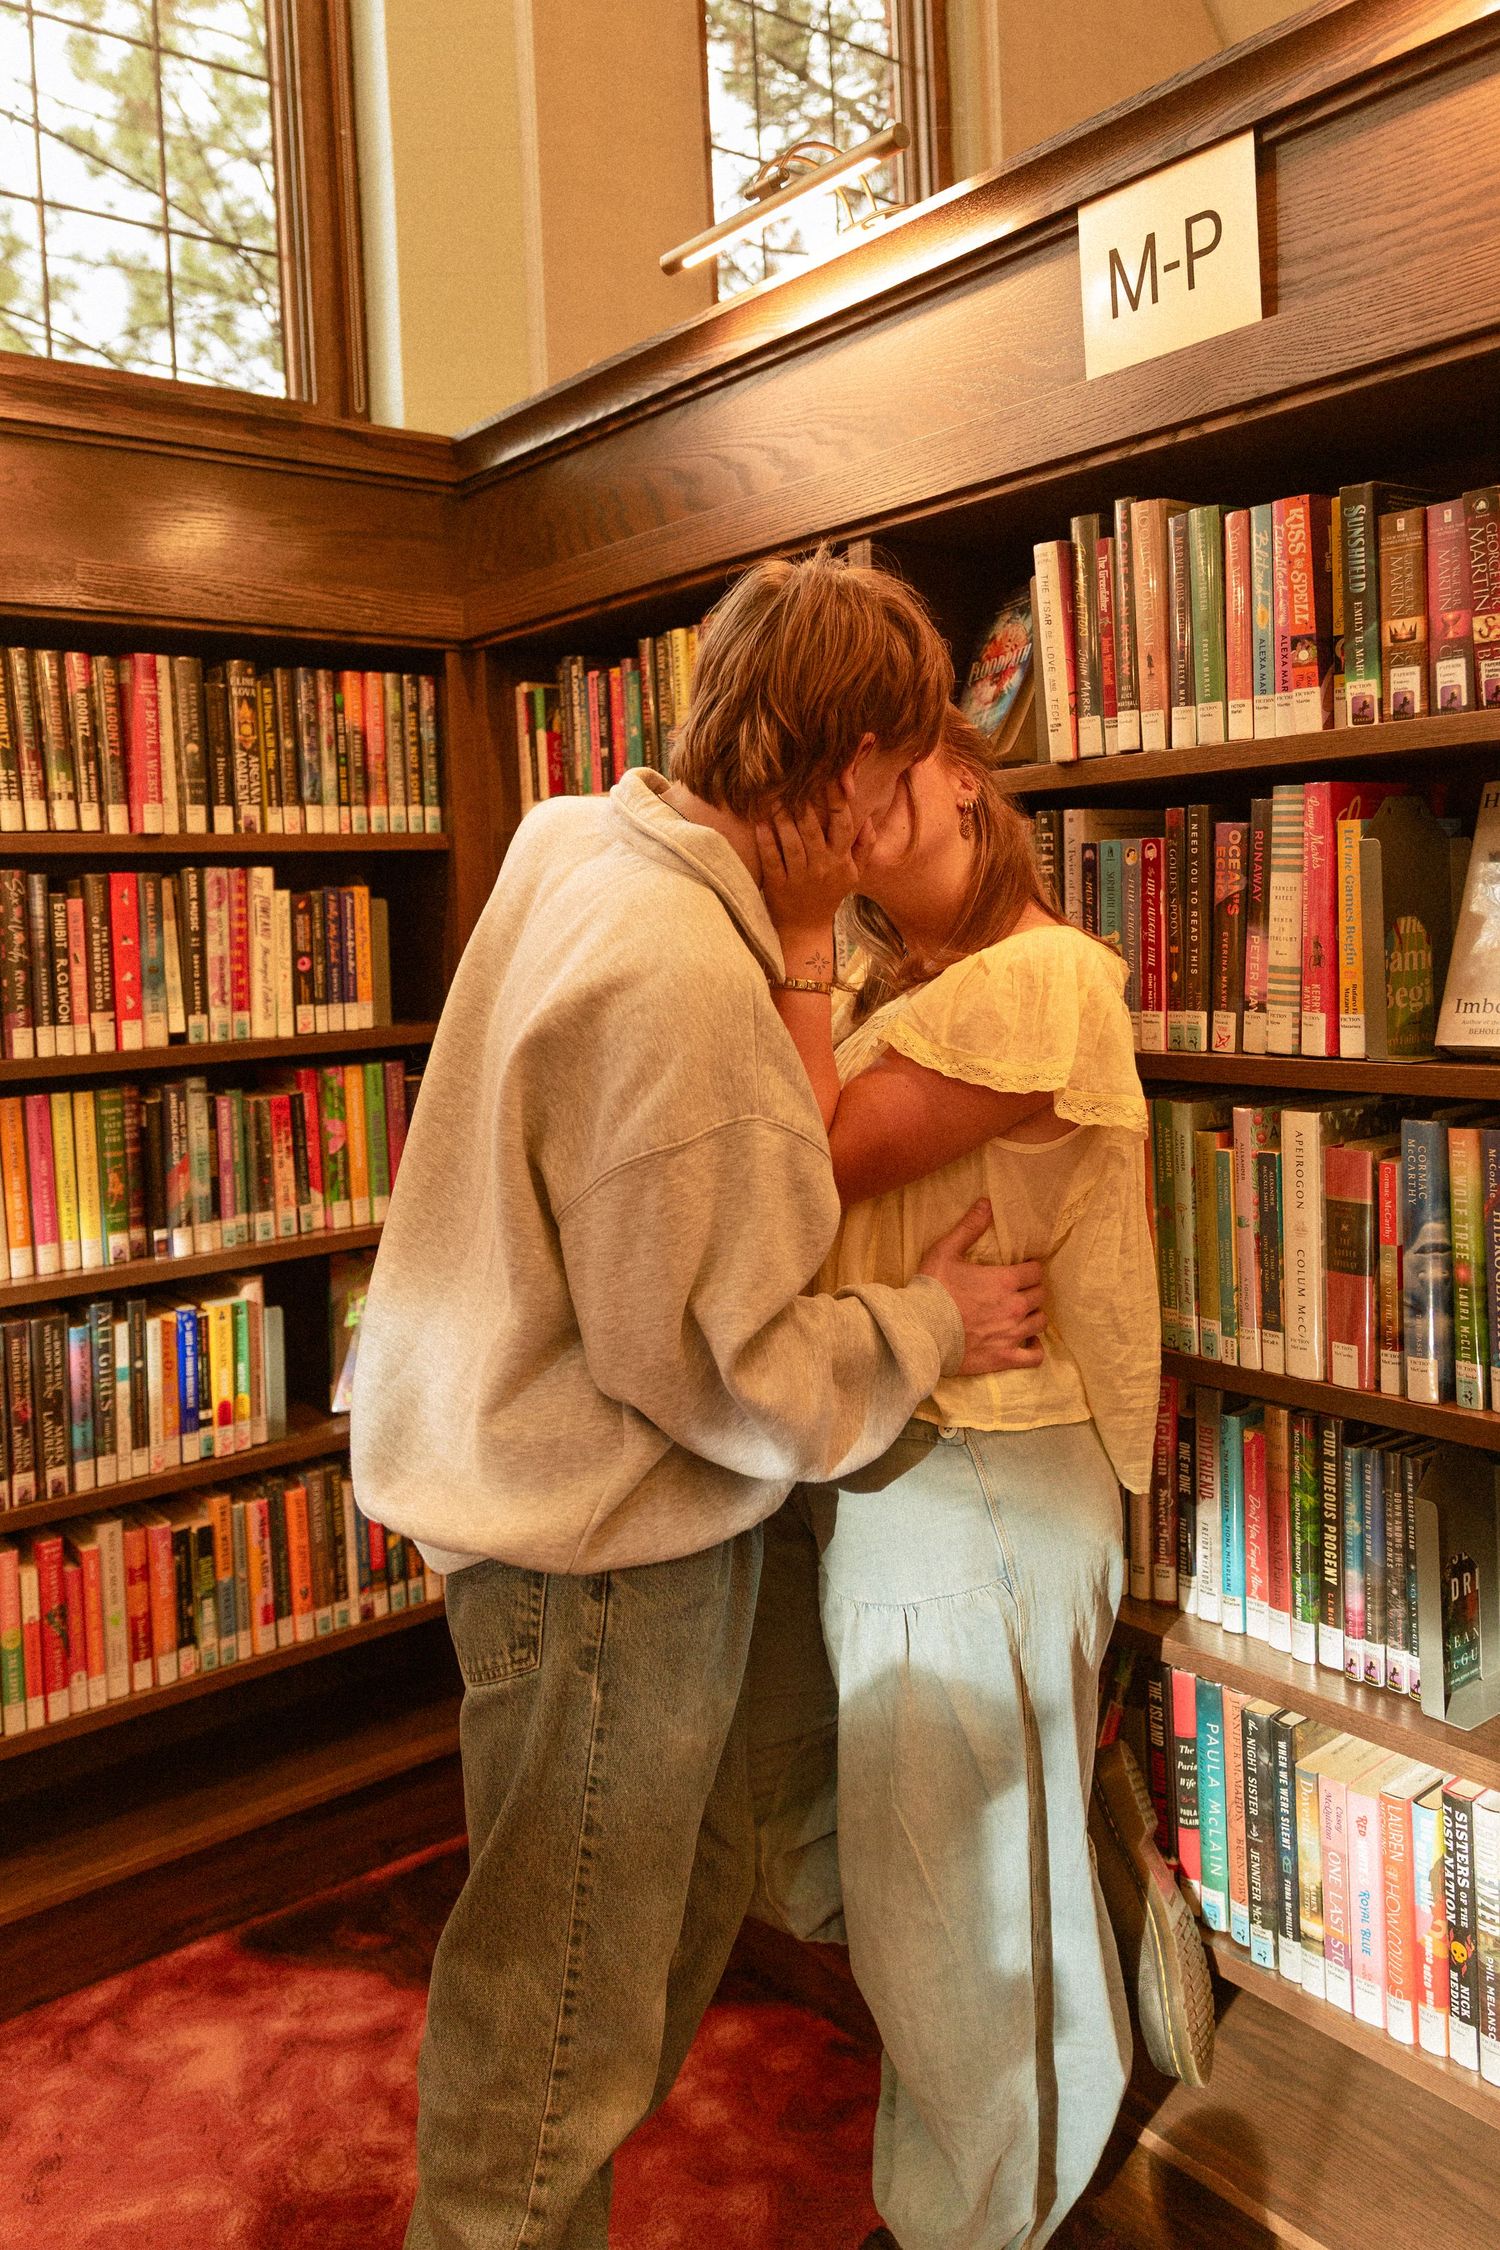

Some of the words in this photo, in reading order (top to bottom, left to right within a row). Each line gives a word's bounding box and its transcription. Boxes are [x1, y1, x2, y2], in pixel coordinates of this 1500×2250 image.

[1108, 209, 1223, 320] M-P
[1285, 507, 1307, 555] KISS
[1344, 504, 1367, 593] SUNSHIELD
[1098, 556, 1108, 570] The
[1175, 536, 1184, 603] MARVELLOUS
[1255, 530, 1270, 595] Blitzed
[1438, 549, 1452, 611] MARTIN
[1468, 526, 1490, 612] MARTIN
[1040, 575, 1050, 593] THE
[1099, 570, 1109, 612] Greenfather
[1290, 571, 1309, 624] SPELL
[1390, 556, 1405, 616] MARTIN
[1043, 600, 1052, 626] TSAR
[1075, 578, 1089, 638] VACATION
[1353, 601, 1364, 633] EMILY
[1046, 646, 1056, 673] LOVE
[1258, 638, 1266, 671] ALEXA
[1280, 634, 1289, 667] ALEXA
[1354, 635, 1363, 646] B.
[75, 660, 85, 689] DEAN
[1077, 649, 1088, 676] JOHN
[1203, 666, 1211, 697] MARSKE
[103, 669, 116, 703] DEAN
[21, 699, 35, 750] KOONTZ
[51, 701, 64, 750] KOONTZ
[76, 693, 90, 737] KOONTZ
[105, 707, 120, 757] KOONTZ
[248, 755, 261, 804] ARCANA
[1309, 831, 1325, 870] Marks
[1343, 828, 1355, 849] Let
[1068, 848, 1077, 873] Twist
[1169, 849, 1177, 895] GOLDEN
[1215, 846, 1226, 901] ECHO
[1252, 830, 1264, 903] RUNAWAY
[1344, 853, 1355, 871] the
[188, 874, 198, 898] DARK
[1191, 890, 1198, 905] TO
[1345, 874, 1357, 923] Games
[53, 903, 67, 948] EXHIBIT
[91, 916, 99, 929] OF
[190, 901, 200, 932] MUSIC
[1170, 898, 1178, 938] SPOON
[92, 933, 101, 973] BURNED
[1249, 935, 1260, 981] PETER
[1343, 925, 1356, 966] Begin
[14, 970, 25, 1000] KEVIN
[95, 977, 104, 1010] BOOKS
[102, 949, 110, 1000] LIBRARIAN
[58, 988, 70, 1023] KWON
[1311, 983, 1321, 1013] KERRY
[169, 1093, 178, 1134] AMERICAN
[1164, 1128, 1173, 1178] ALEXANDER
[1295, 1130, 1305, 1210] APEIROGON
[1406, 1138, 1416, 1205] McCARTHY
[1452, 1139, 1465, 1170] THE
[1383, 1166, 1392, 1197] Cormac
[1417, 1145, 1427, 1200] CORMAC
[1488, 1149, 1498, 1199] McCorkle
[1453, 1175, 1469, 1217] WOLF
[1383, 1200, 1393, 1239] McCarthy
[1168, 1249, 1176, 1267] HOW
[1454, 1223, 1471, 1260] TREE
[1297, 1249, 1306, 1298] COLUM
[1458, 1288, 1469, 1321] LAURA
[97, 1311, 112, 1349] ALL
[99, 1354, 114, 1412] GIRLS
[55, 1425, 64, 1463] MARK
[1178, 1442, 1192, 1460] ONE
[1323, 1429, 1336, 1457] OUR
[1180, 1463, 1189, 1474] BY
[1198, 1426, 1214, 1500] BOYFRIEND
[1344, 1461, 1352, 1498] BENEATH
[1179, 1475, 1191, 1493] ONE
[1323, 1461, 1337, 1518] HIDEOUS
[1158, 1488, 1170, 1526] Sweet
[1364, 1489, 1372, 1531] TUMBLING
[1201, 1522, 1210, 1550] FREIDA
[1248, 1523, 1259, 1539] You
[1272, 1515, 1283, 1545] Fiona
[1394, 1520, 1402, 1550] AMONG
[1248, 1542, 1261, 1569] Forget
[1294, 1531, 1302, 1574] ABERNATHY
[1324, 1524, 1337, 1586] PROGENY
[1148, 1680, 1163, 1704] THE
[1149, 1705, 1165, 1746] ISLAND
[1230, 1700, 1242, 1765] JENNIFER
[1247, 1719, 1259, 1736] the
[1178, 1760, 1197, 1771] Paris
[1179, 1744, 1195, 1755] The
[1206, 1722, 1222, 1788] PAULA
[1246, 1737, 1257, 1772] NIGHT
[1277, 1741, 1288, 1768] WHEN
[1180, 1776, 1196, 1788] Wife
[1232, 1767, 1244, 1823] McMAHON
[1248, 1776, 1259, 1816] SISTER
[1278, 1770, 1289, 1784] WE
[1180, 1807, 1198, 1817] PAULA
[1279, 1788, 1289, 1814] WERE
[1322, 1789, 1333, 1841] McQuiston
[1334, 1806, 1344, 1834] Casey
[1208, 1798, 1225, 1877] McLAIN
[1280, 1816, 1291, 1850] SILENT
[1355, 1815, 1368, 1837] RED
[1387, 1804, 1404, 1862] LAUREN
[1442, 1804, 1454, 1852] LOST
[1327, 1851, 1342, 1884] ONE
[1454, 1810, 1470, 1888] SISTERS
[1235, 1837, 1247, 1904] BURNTOWN
[1249, 1848, 1262, 1901] JENNIFER
[1284, 1879, 1292, 1900] FIONA
[1359, 1890, 1370, 1924] ROYAL
[1444, 1854, 1456, 1926] NATION
[1460, 1892, 1468, 1905] OF
[1329, 1890, 1345, 1937] LAST
[1460, 1907, 1469, 1928] THE
[1361, 1928, 1372, 1956] BLUE
[1387, 1929, 1404, 1986] COULD
[1486, 1956, 1496, 1982] PHIL
[1460, 1984, 1470, 2018] NICK
